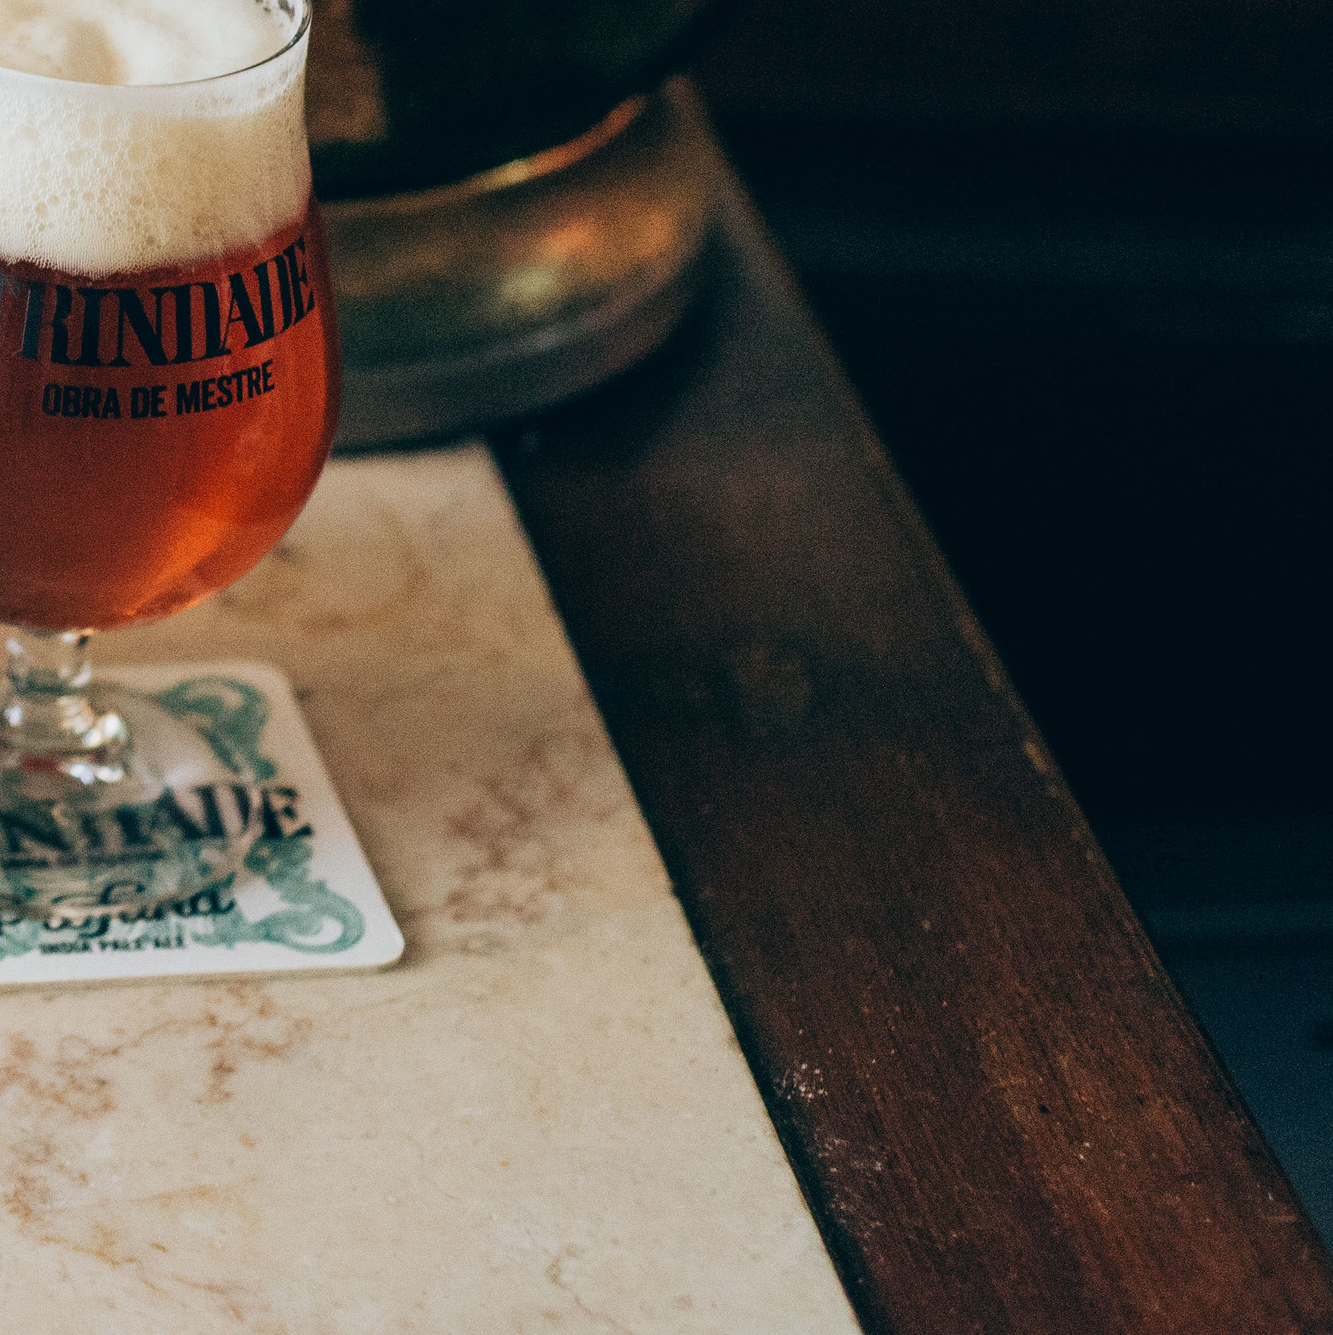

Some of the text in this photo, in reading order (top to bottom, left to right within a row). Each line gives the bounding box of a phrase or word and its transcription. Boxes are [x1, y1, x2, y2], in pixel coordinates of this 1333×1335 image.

[41, 359, 276, 419] OBRA DE MESTRE
